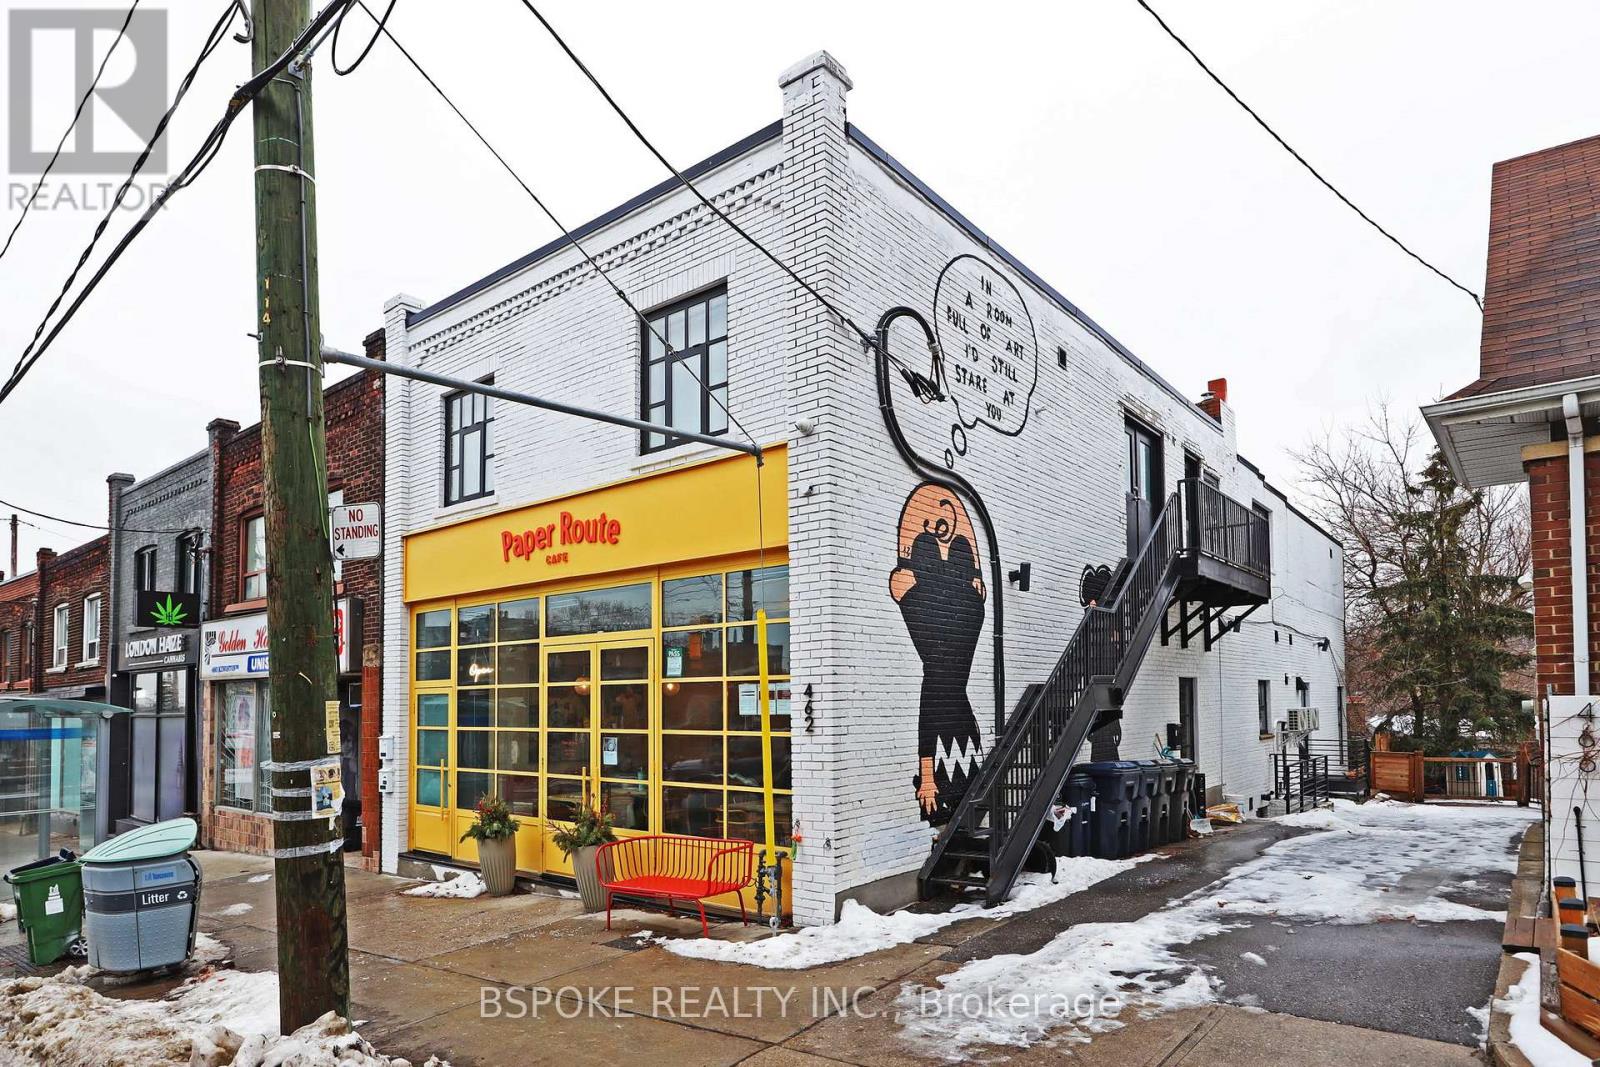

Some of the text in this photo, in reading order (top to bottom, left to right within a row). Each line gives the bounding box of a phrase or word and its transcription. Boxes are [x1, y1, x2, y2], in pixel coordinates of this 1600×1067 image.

[980, 275, 992, 296] IN
[964, 290, 1013, 329] A ROOM
[947, 304, 1024, 360] FULL OF ART
[964, 344, 1019, 383] I'D STILL
[955, 363, 1015, 406] STARE AT
[985, 401, 1002, 421] YOU
[348, 508, 364, 523] NO
[334, 523, 379, 541] STANDING
[501, 511, 622, 563] Paper Route
[545, 552, 569, 565] CAFE
[125, 633, 183, 658] LONDON HAZE
[218, 629, 247, 653] Golden
[251, 656, 270, 671] UNIS
[668, 649, 681, 657] PASS
[142, 893, 170, 905] Litter
